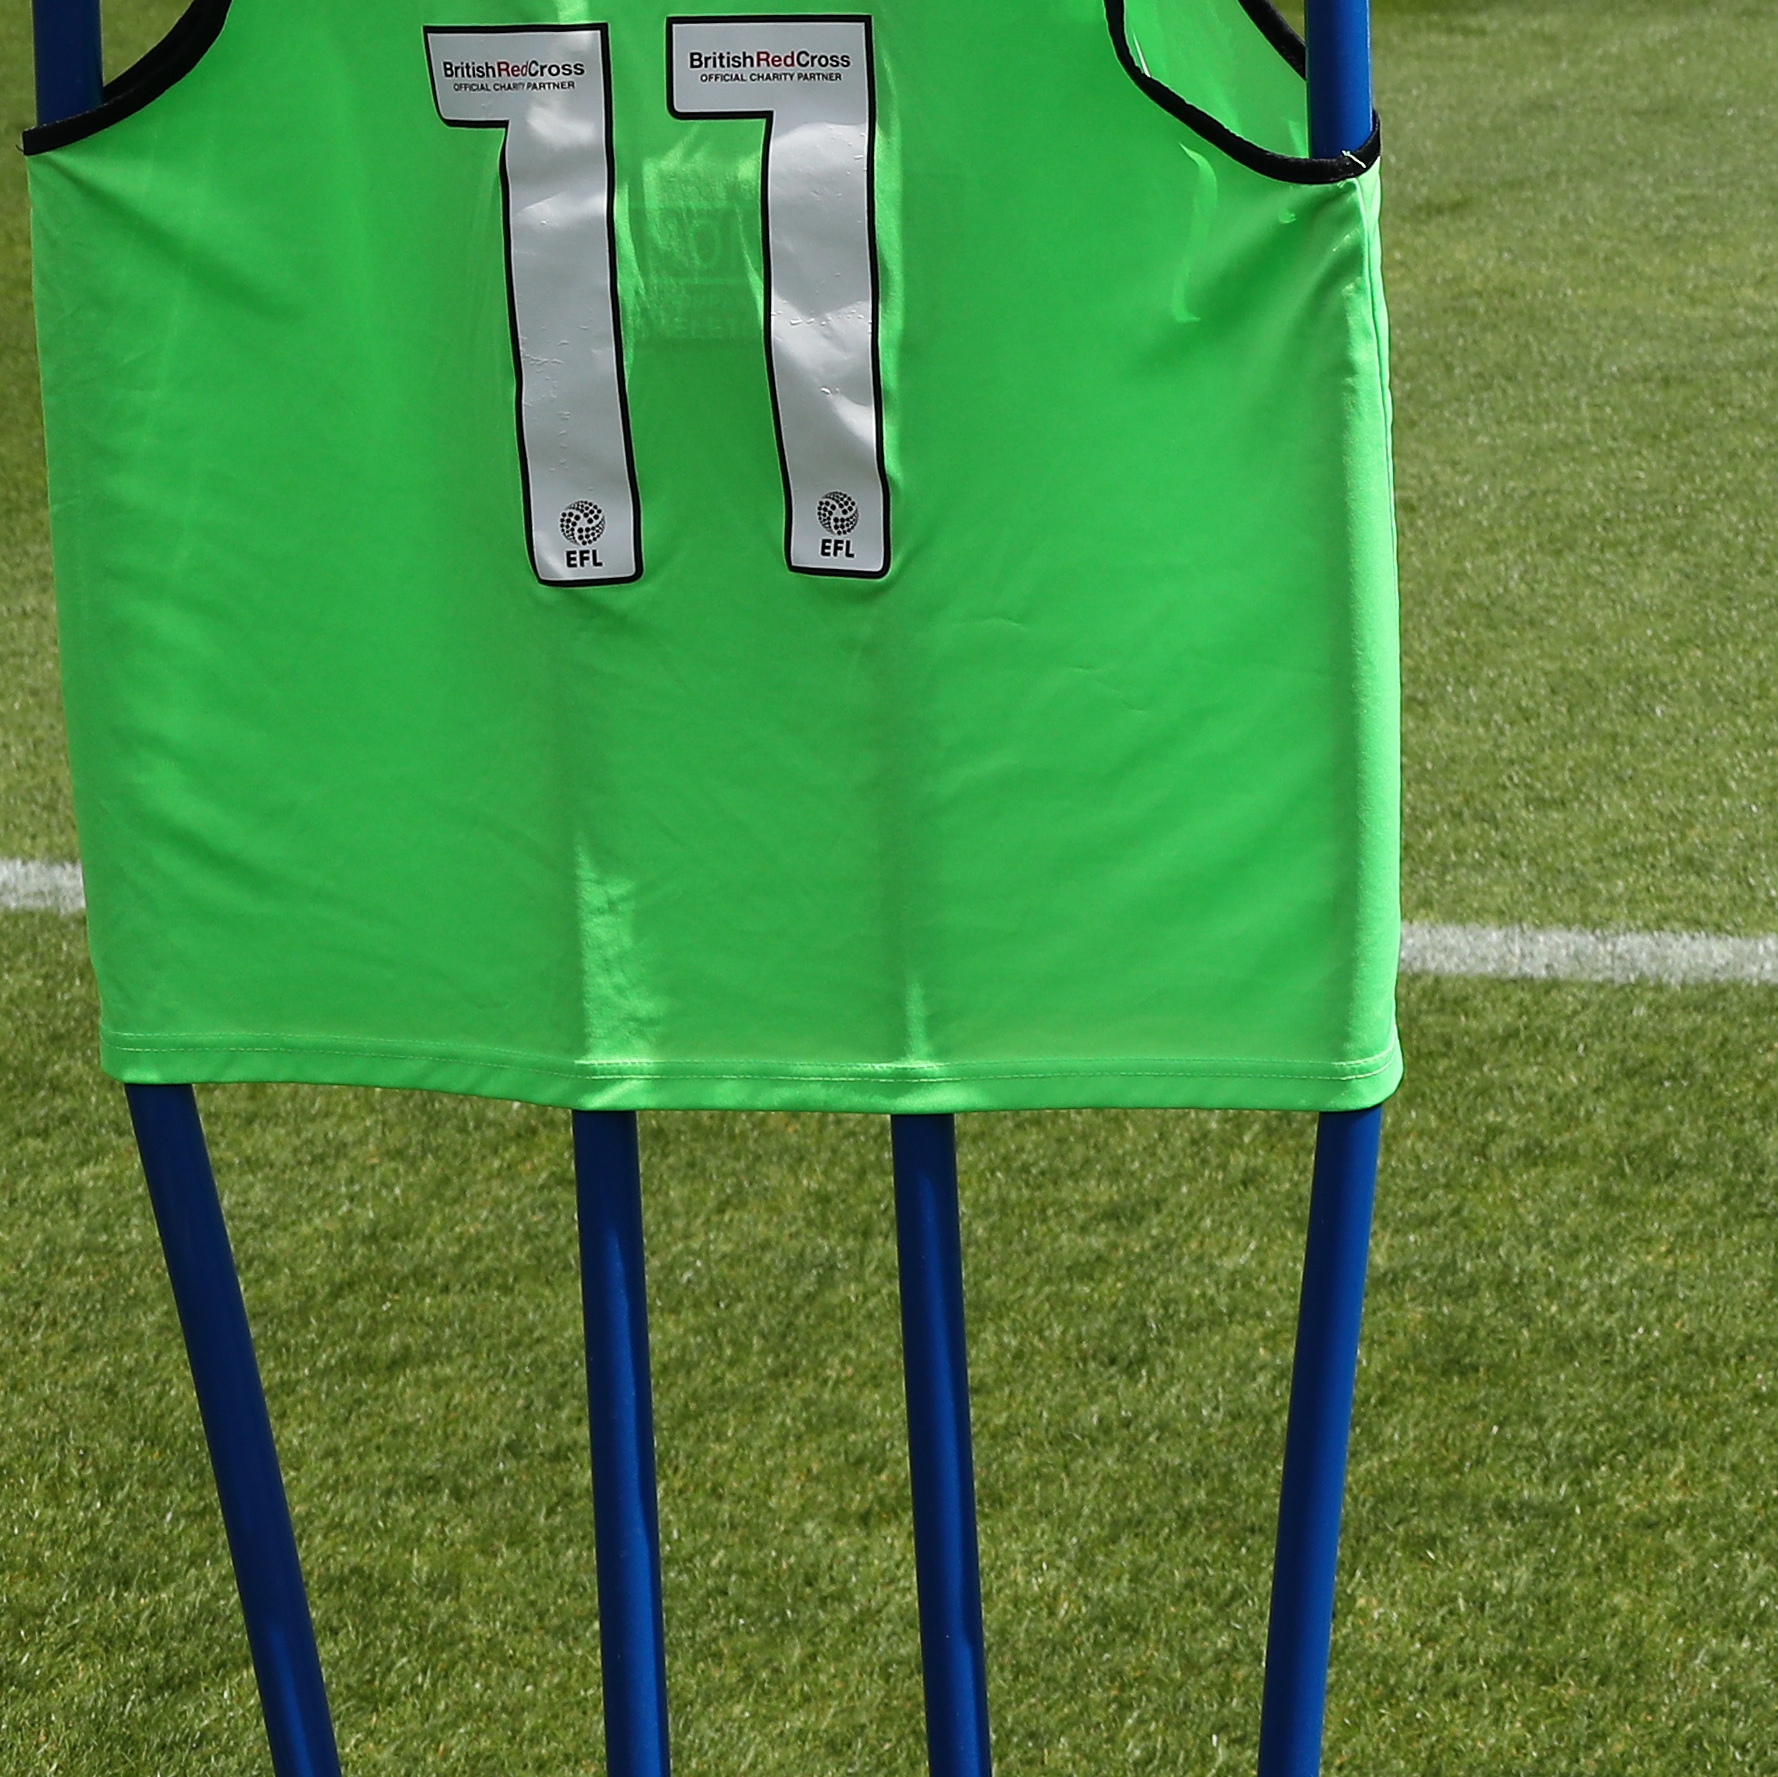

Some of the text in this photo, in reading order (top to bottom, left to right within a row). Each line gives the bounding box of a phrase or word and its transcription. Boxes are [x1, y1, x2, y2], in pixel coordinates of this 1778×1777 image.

[453, 81, 491, 92] OFFICIAL
[526, 80, 576, 92] PARTNER
[699, 72, 842, 83] OFFICIAL CHARITY PARTNER
[421, 15, 893, 586] 11
[820, 538, 856, 558] EFL
[565, 549, 604, 568] EFL
